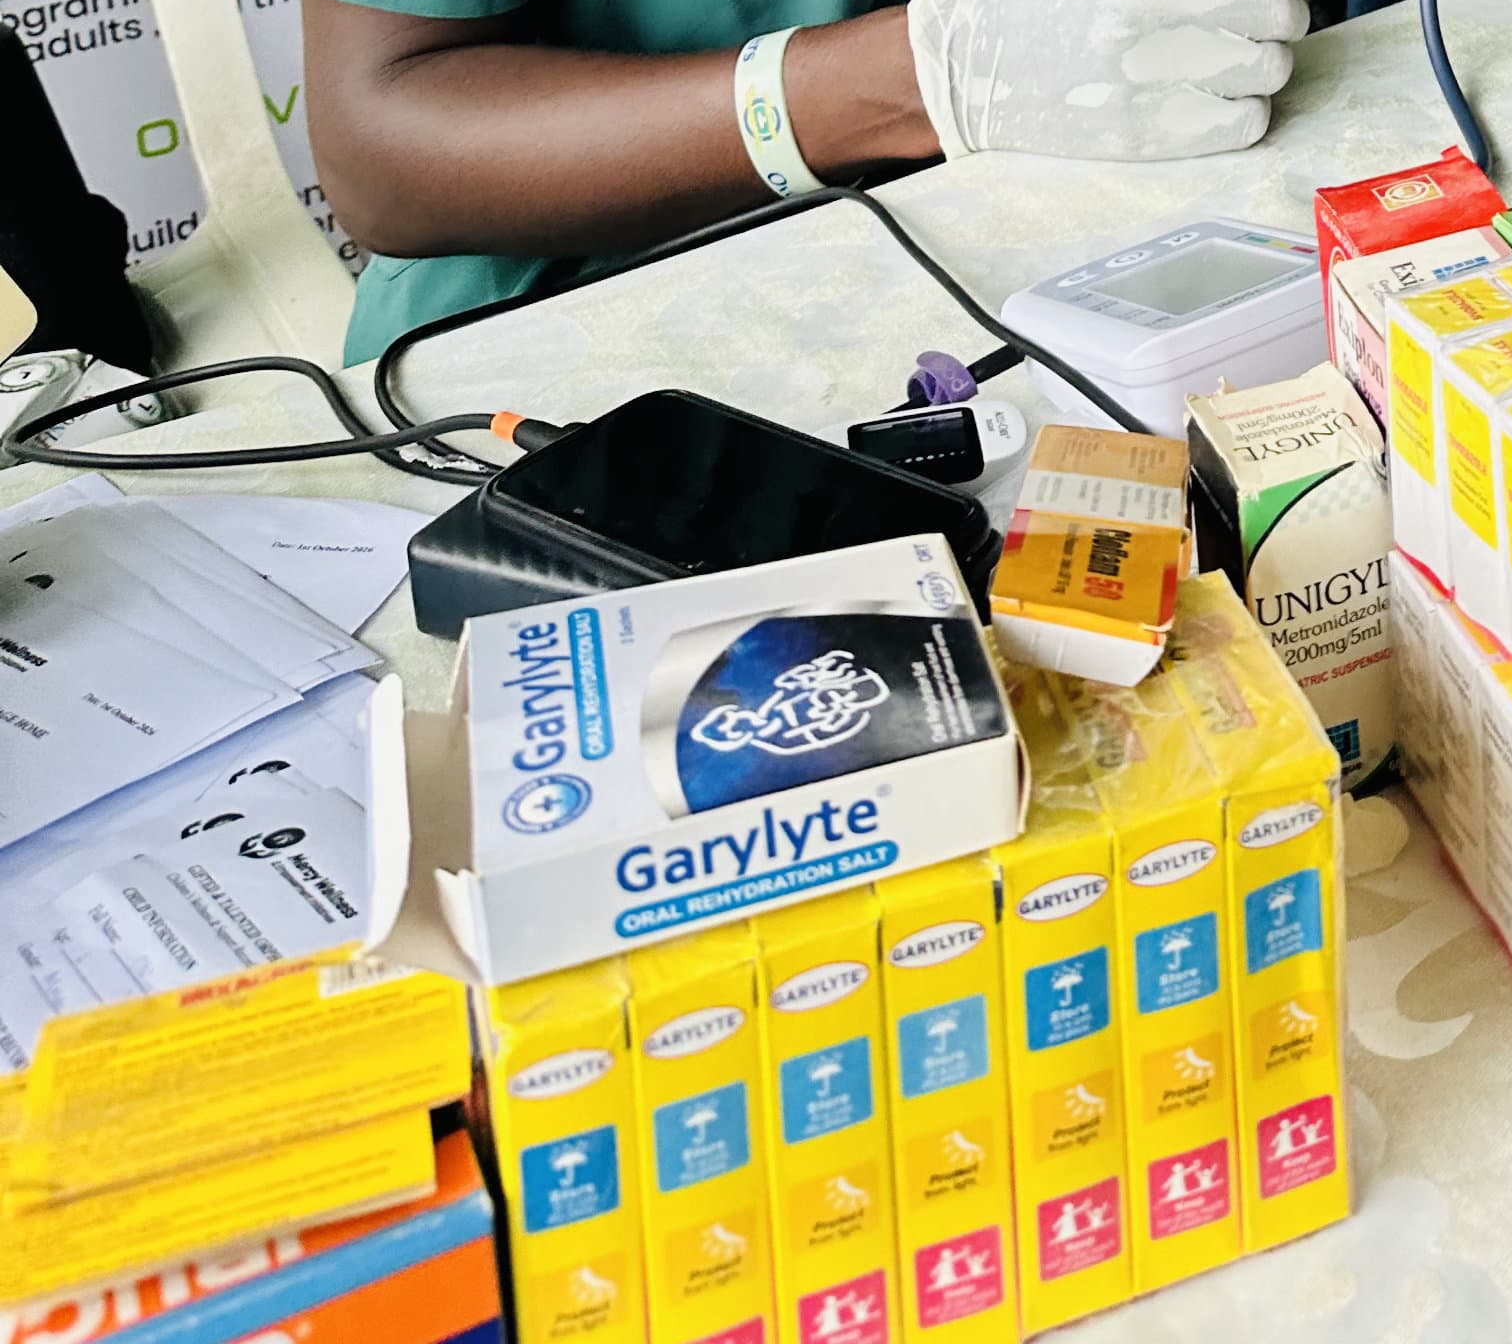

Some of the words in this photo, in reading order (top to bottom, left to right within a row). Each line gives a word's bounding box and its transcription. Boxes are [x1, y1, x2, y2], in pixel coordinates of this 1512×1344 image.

[1233, 412, 1358, 462] UNIGYL
[1083, 577, 1125, 599] 50
[575, 613, 592, 637] SALT
[1271, 597, 1391, 648] Metronidazole
[1284, 619, 1382, 667] 200mg/5ml
[578, 638, 602, 714] REHYDRATION
[502, 623, 572, 771] Garylyte
[583, 716, 605, 755] ORAL
[616, 794, 880, 892] Garylyte
[1241, 808, 1318, 844] GARYLYTE
[1128, 848, 1212, 881] GARYLYTE
[623, 903, 683, 932] ORAL
[688, 866, 832, 925] REHYDRATION
[837, 845, 892, 874] SALT
[1019, 879, 1104, 915] GARYLYTE
[892, 928, 981, 962] GARYLYTE
[774, 965, 865, 1006] GARYLYTE
[648, 1012, 738, 1053] GARYLYTE
